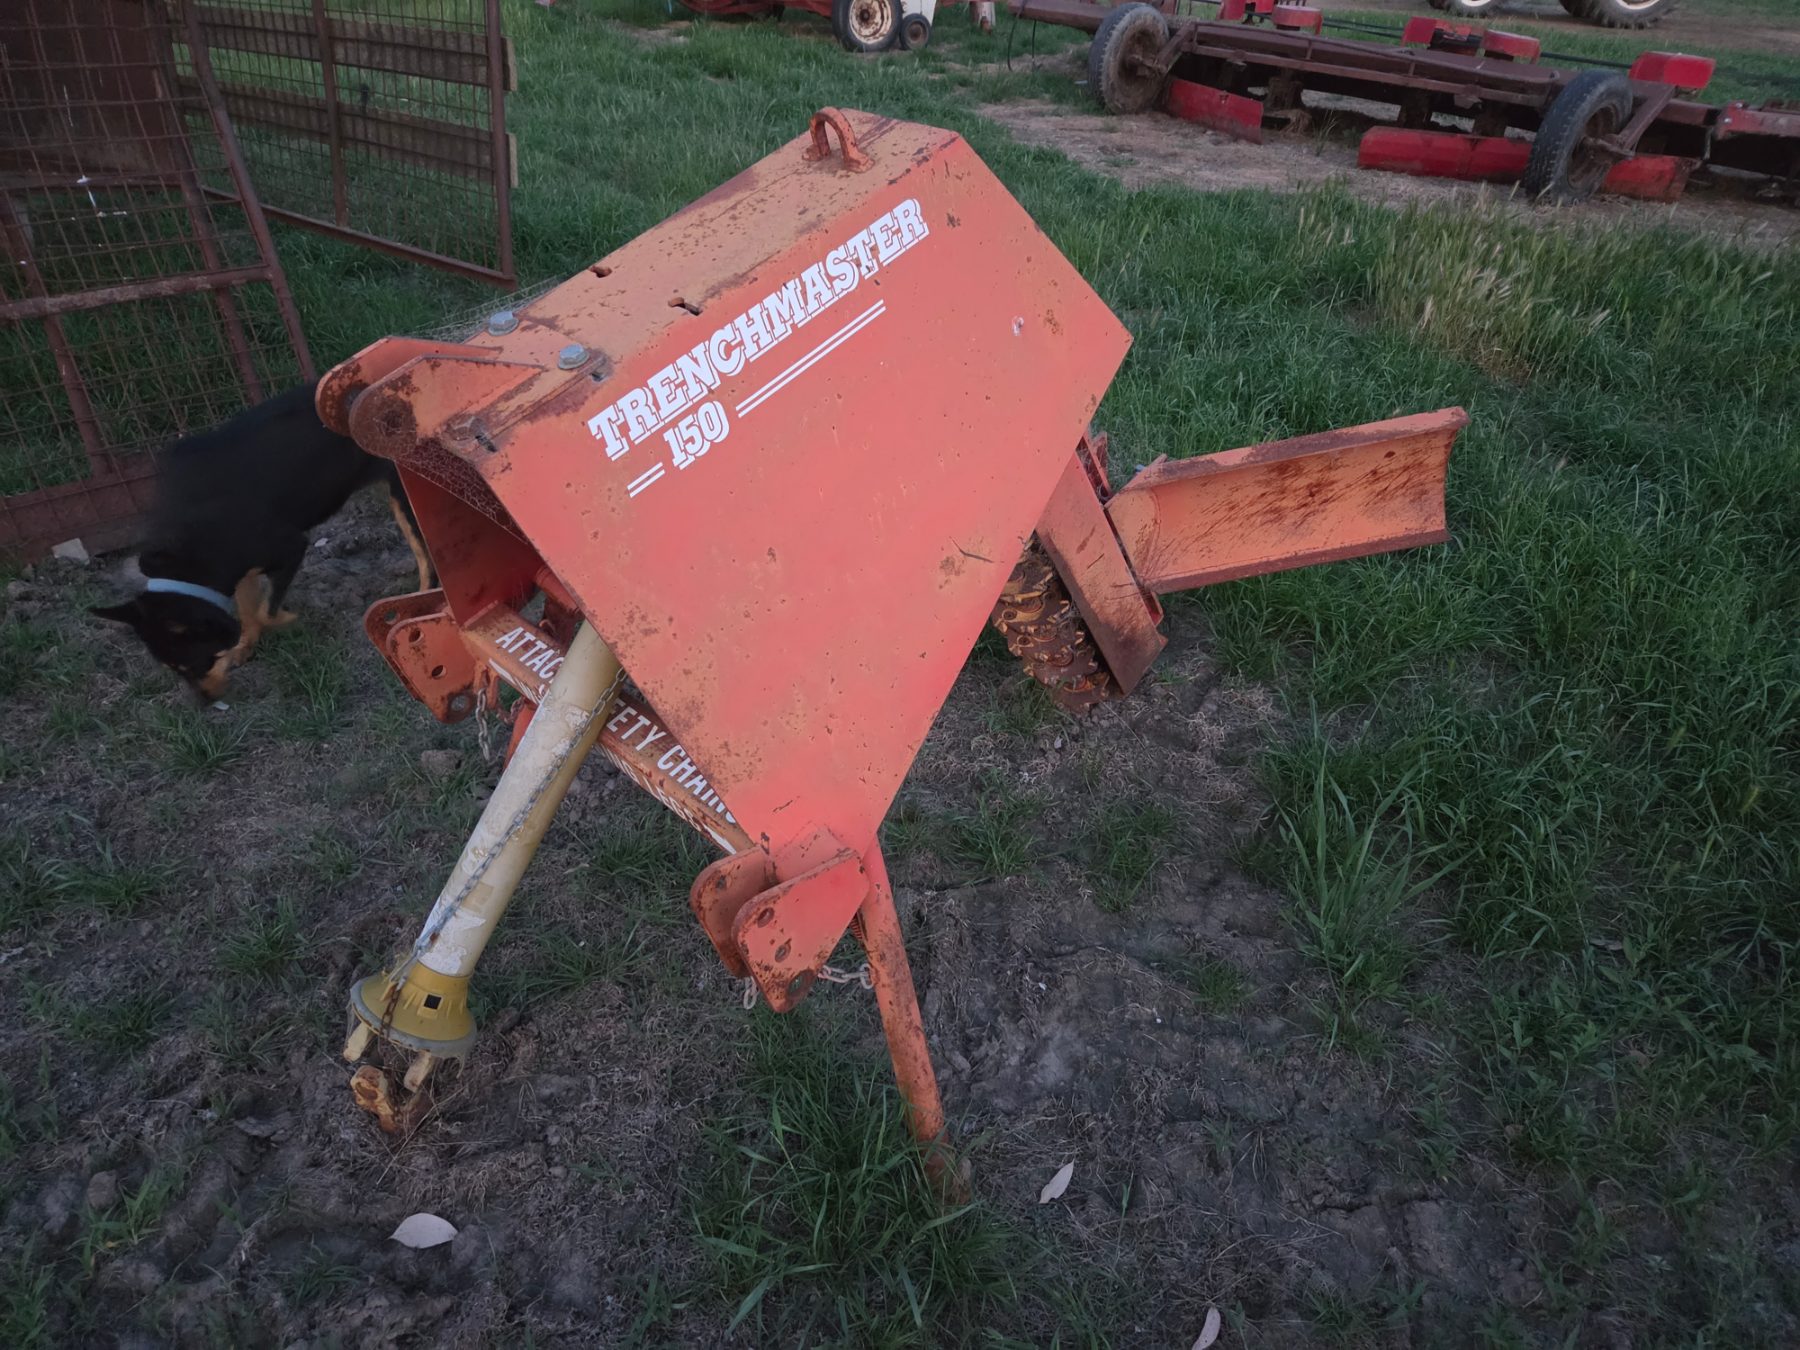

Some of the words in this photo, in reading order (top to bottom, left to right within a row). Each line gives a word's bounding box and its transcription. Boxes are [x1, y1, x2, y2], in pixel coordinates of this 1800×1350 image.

[587, 198, 930, 461] TRENCHMASTER
[663, 400, 730, 470] 150
[495, 626, 565, 683] ATTAC
[657, 744, 736, 824] CHAIN
